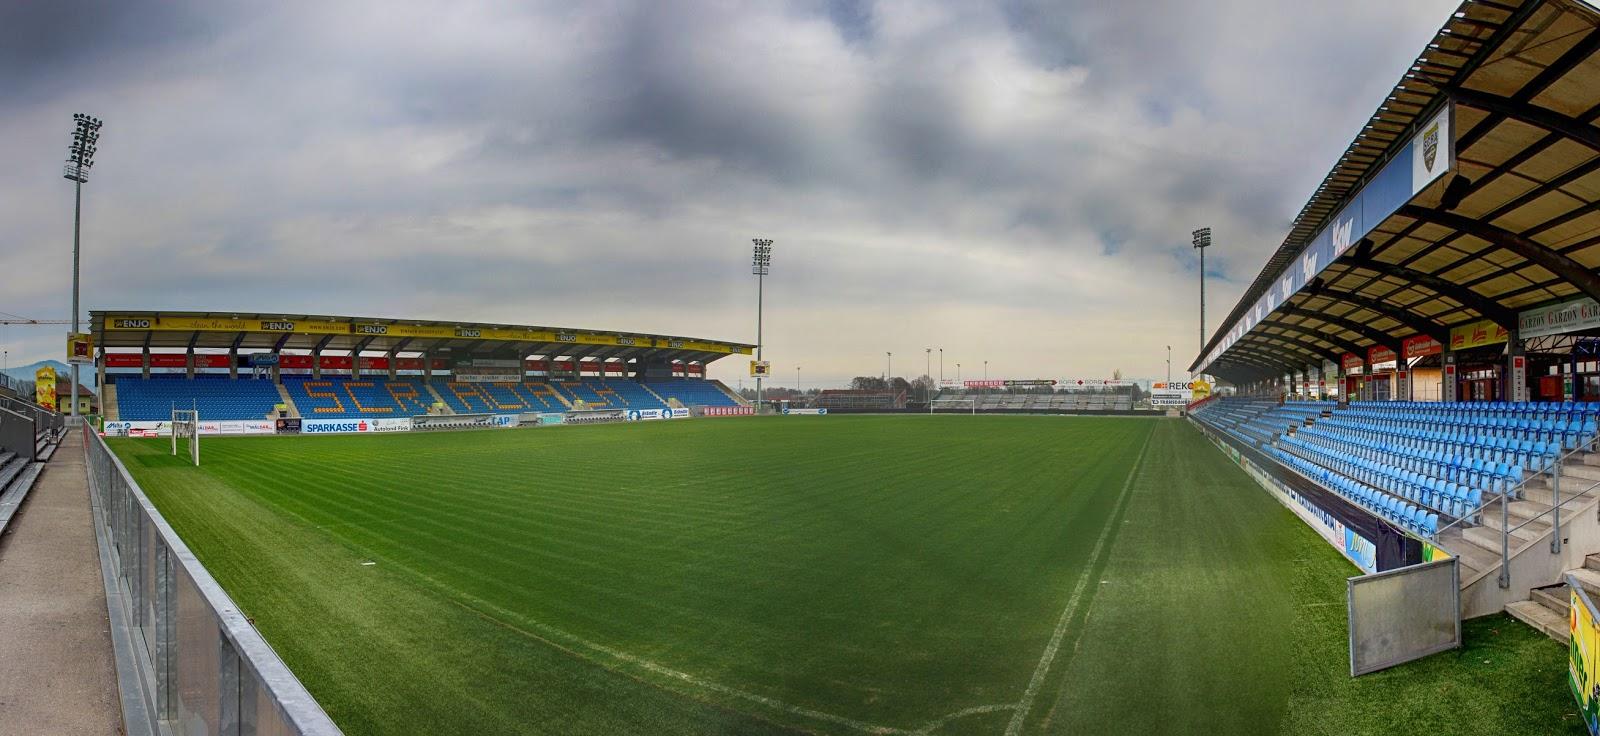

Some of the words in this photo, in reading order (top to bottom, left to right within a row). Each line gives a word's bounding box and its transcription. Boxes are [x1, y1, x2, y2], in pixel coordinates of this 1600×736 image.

[1548, 309, 1577, 325] GARZON
[123, 319, 149, 328] ENJO
[269, 321, 294, 330] ENJO
[1520, 315, 1545, 329] GARZON
[364, 325, 387, 334] ENJO
[307, 423, 358, 432] SPARKASSE
